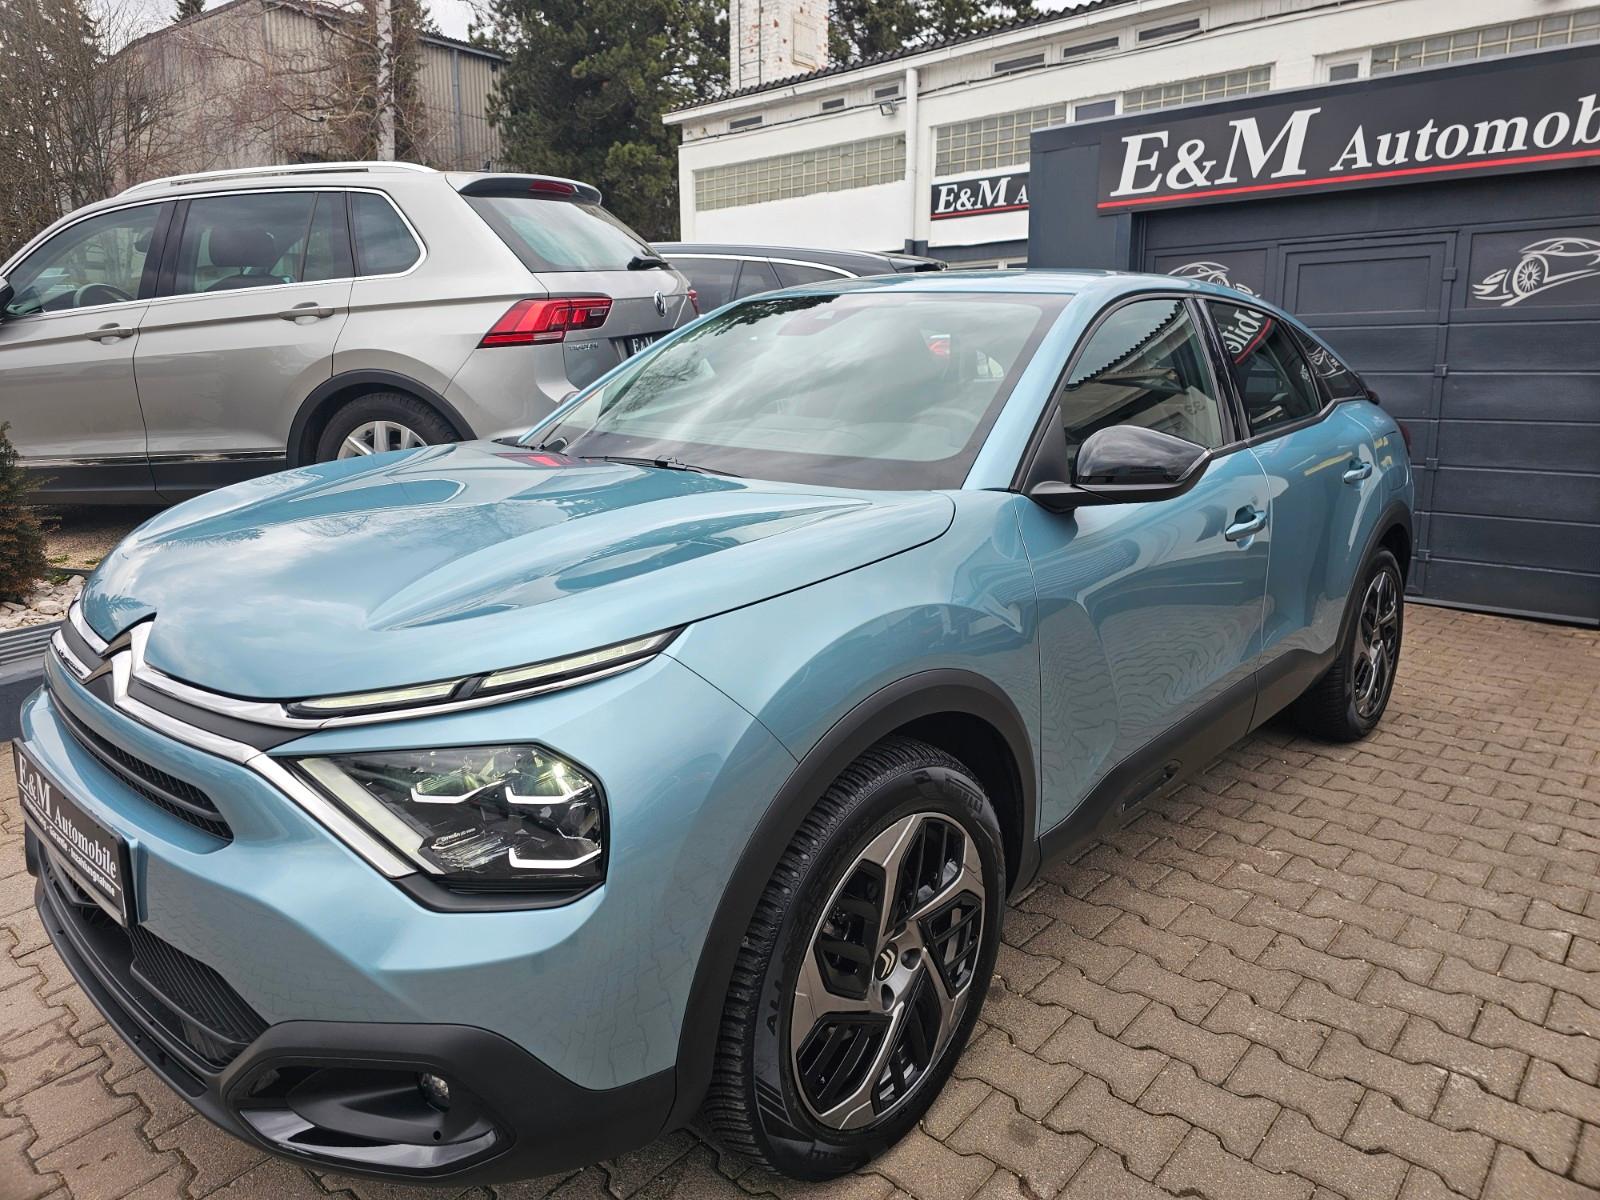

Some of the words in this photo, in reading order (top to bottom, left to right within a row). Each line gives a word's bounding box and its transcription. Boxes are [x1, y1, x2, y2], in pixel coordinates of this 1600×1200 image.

[934, 177, 1011, 214] E&M
[1109, 107, 1321, 198] E&M
[18, 751, 51, 817] E&M
[54, 806, 117, 879] Automobile
